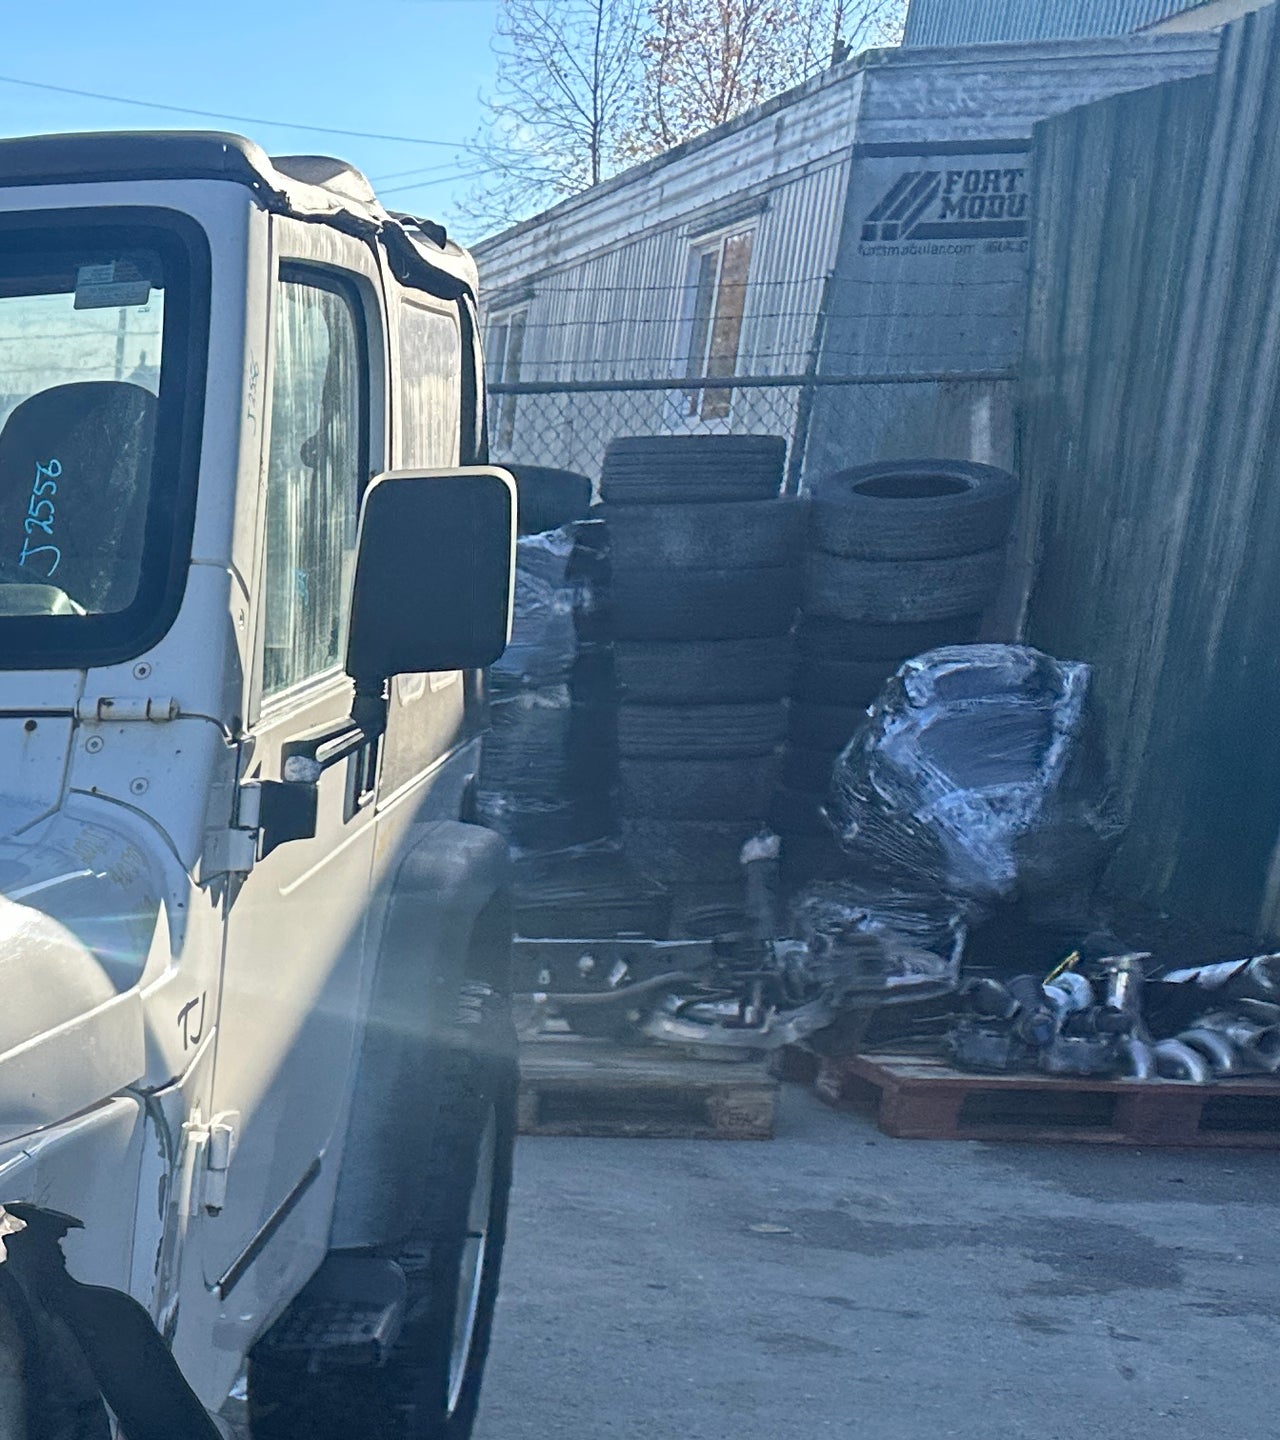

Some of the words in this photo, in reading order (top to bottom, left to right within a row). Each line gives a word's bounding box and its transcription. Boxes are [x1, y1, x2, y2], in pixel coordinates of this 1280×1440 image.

[943, 168, 1025, 194] FORT
[18, 458, 63, 577] J2556
[177, 990, 207, 1051] TJ
